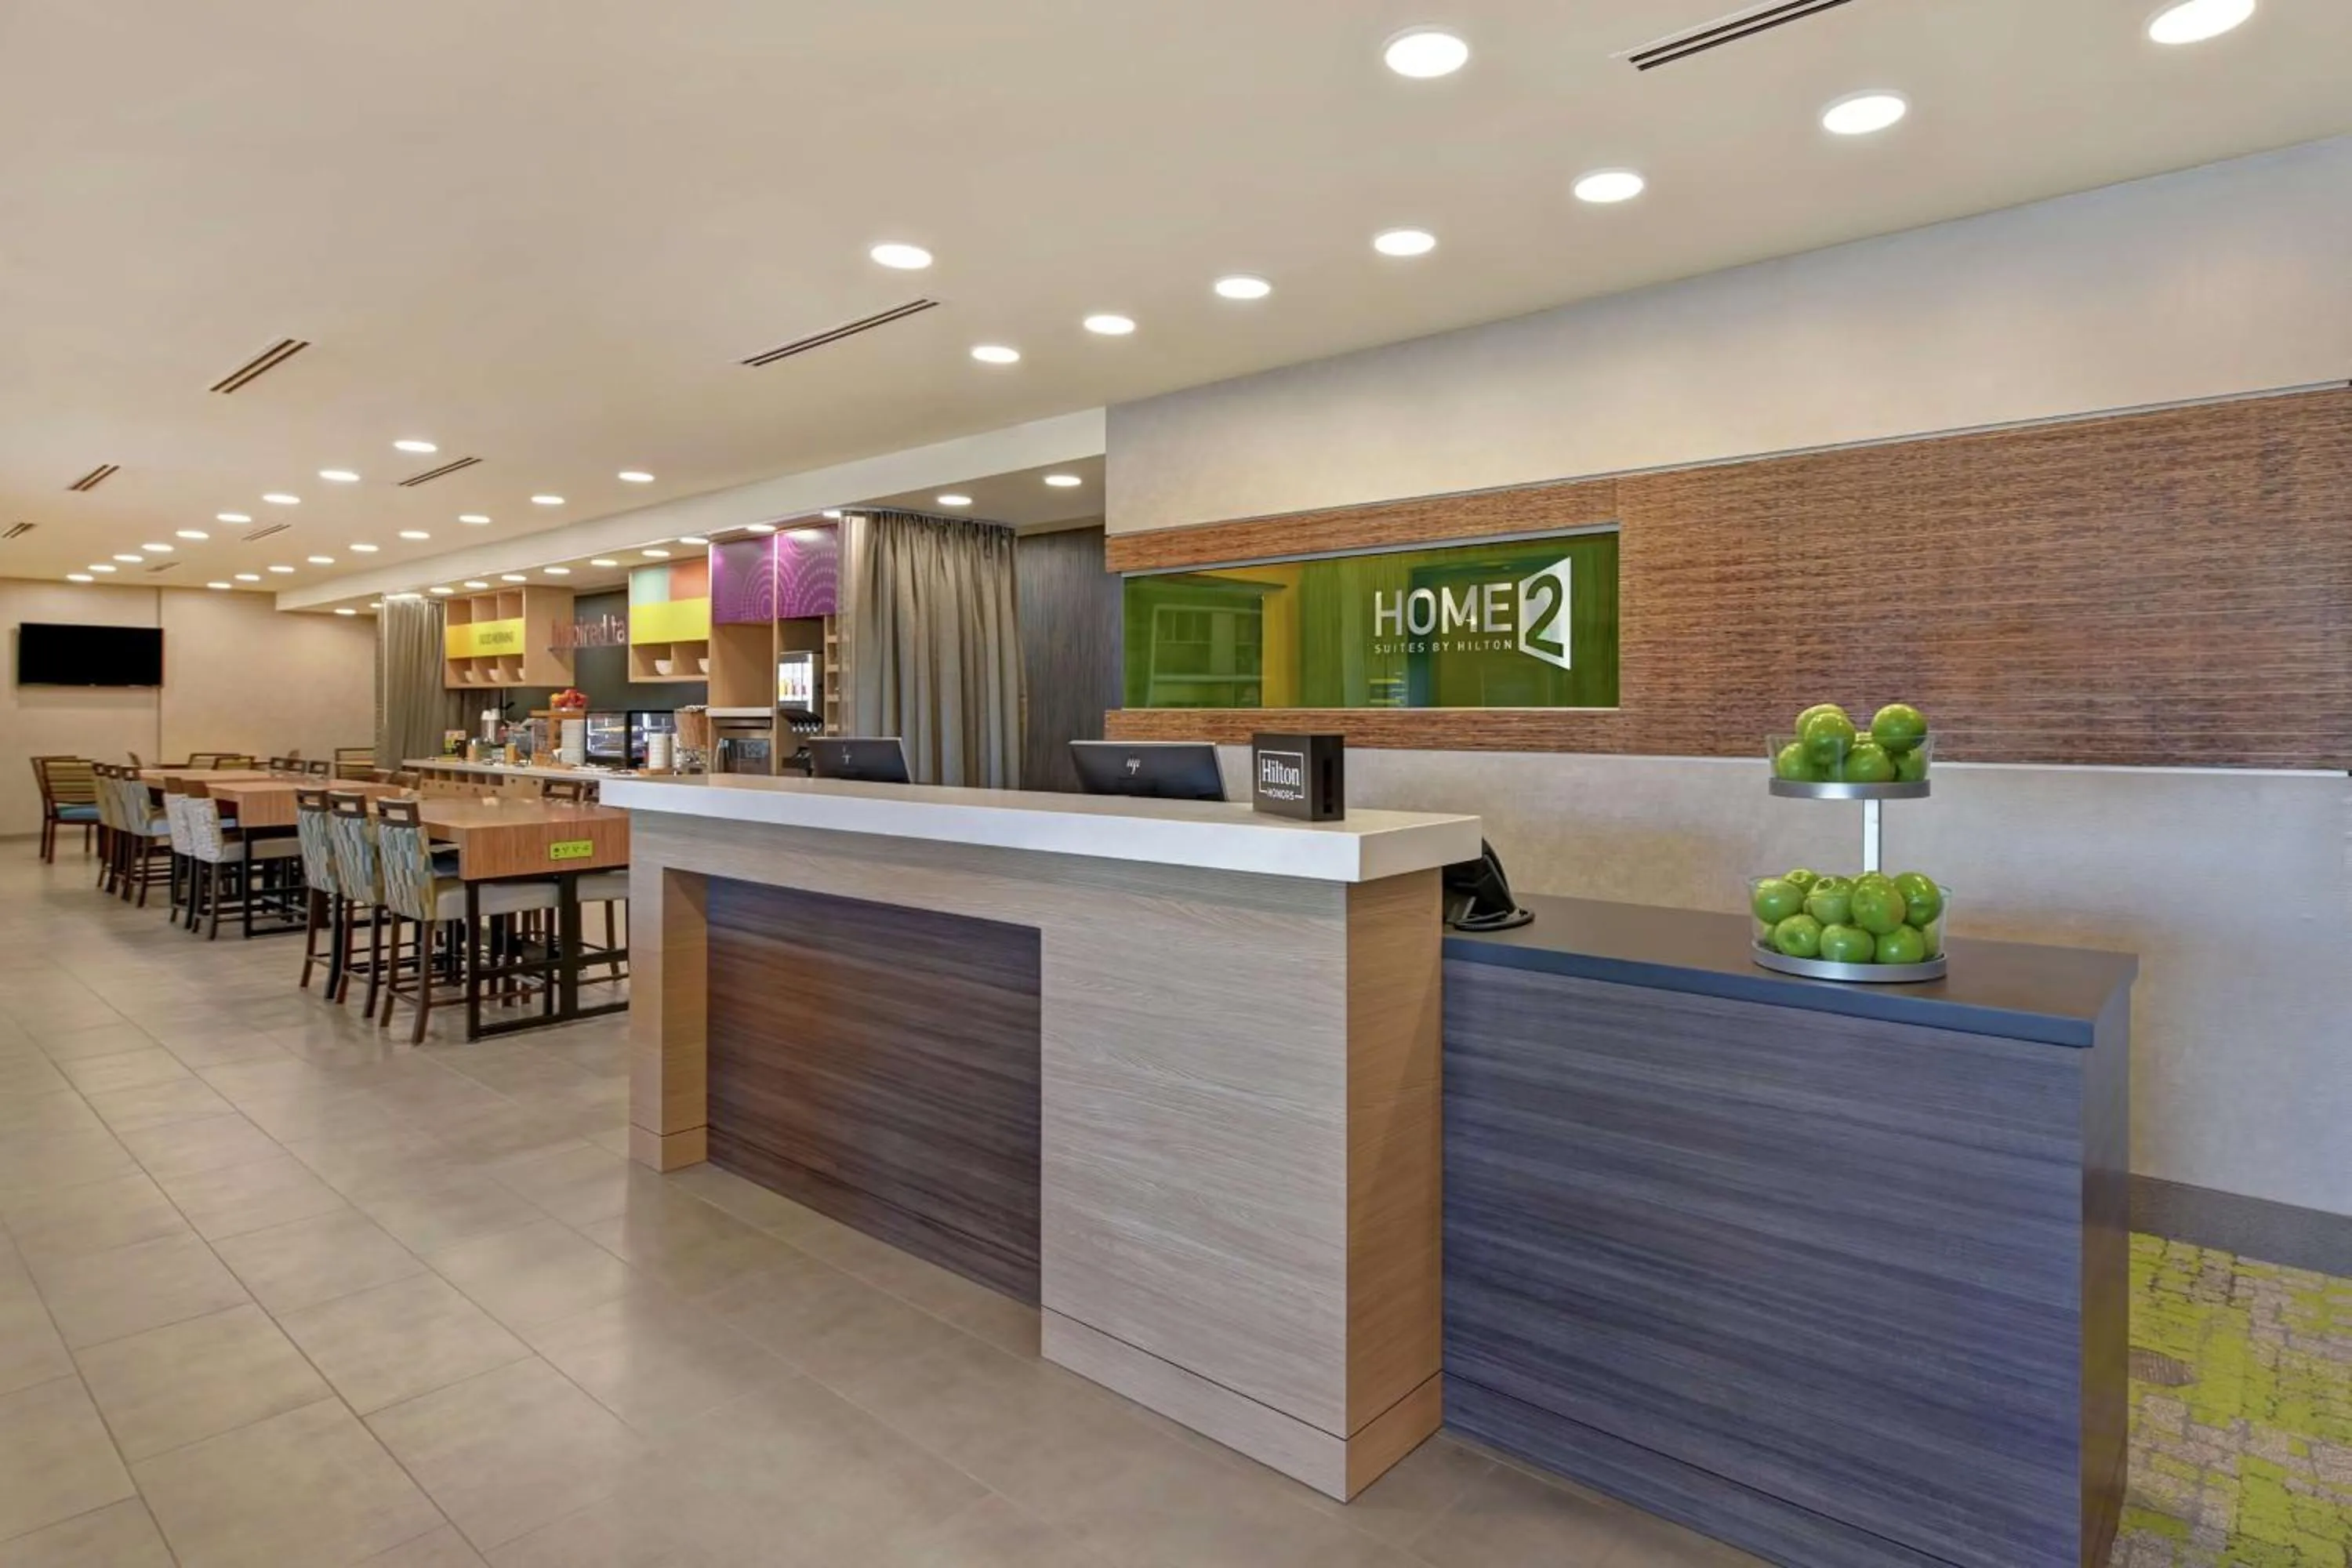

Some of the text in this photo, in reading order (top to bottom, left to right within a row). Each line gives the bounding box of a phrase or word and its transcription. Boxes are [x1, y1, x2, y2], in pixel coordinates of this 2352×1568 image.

[610, 615, 628, 644] ta
[1374, 639, 1512, 654] SUITES BY HILTON
[1261, 758, 1300, 786] Hilton
